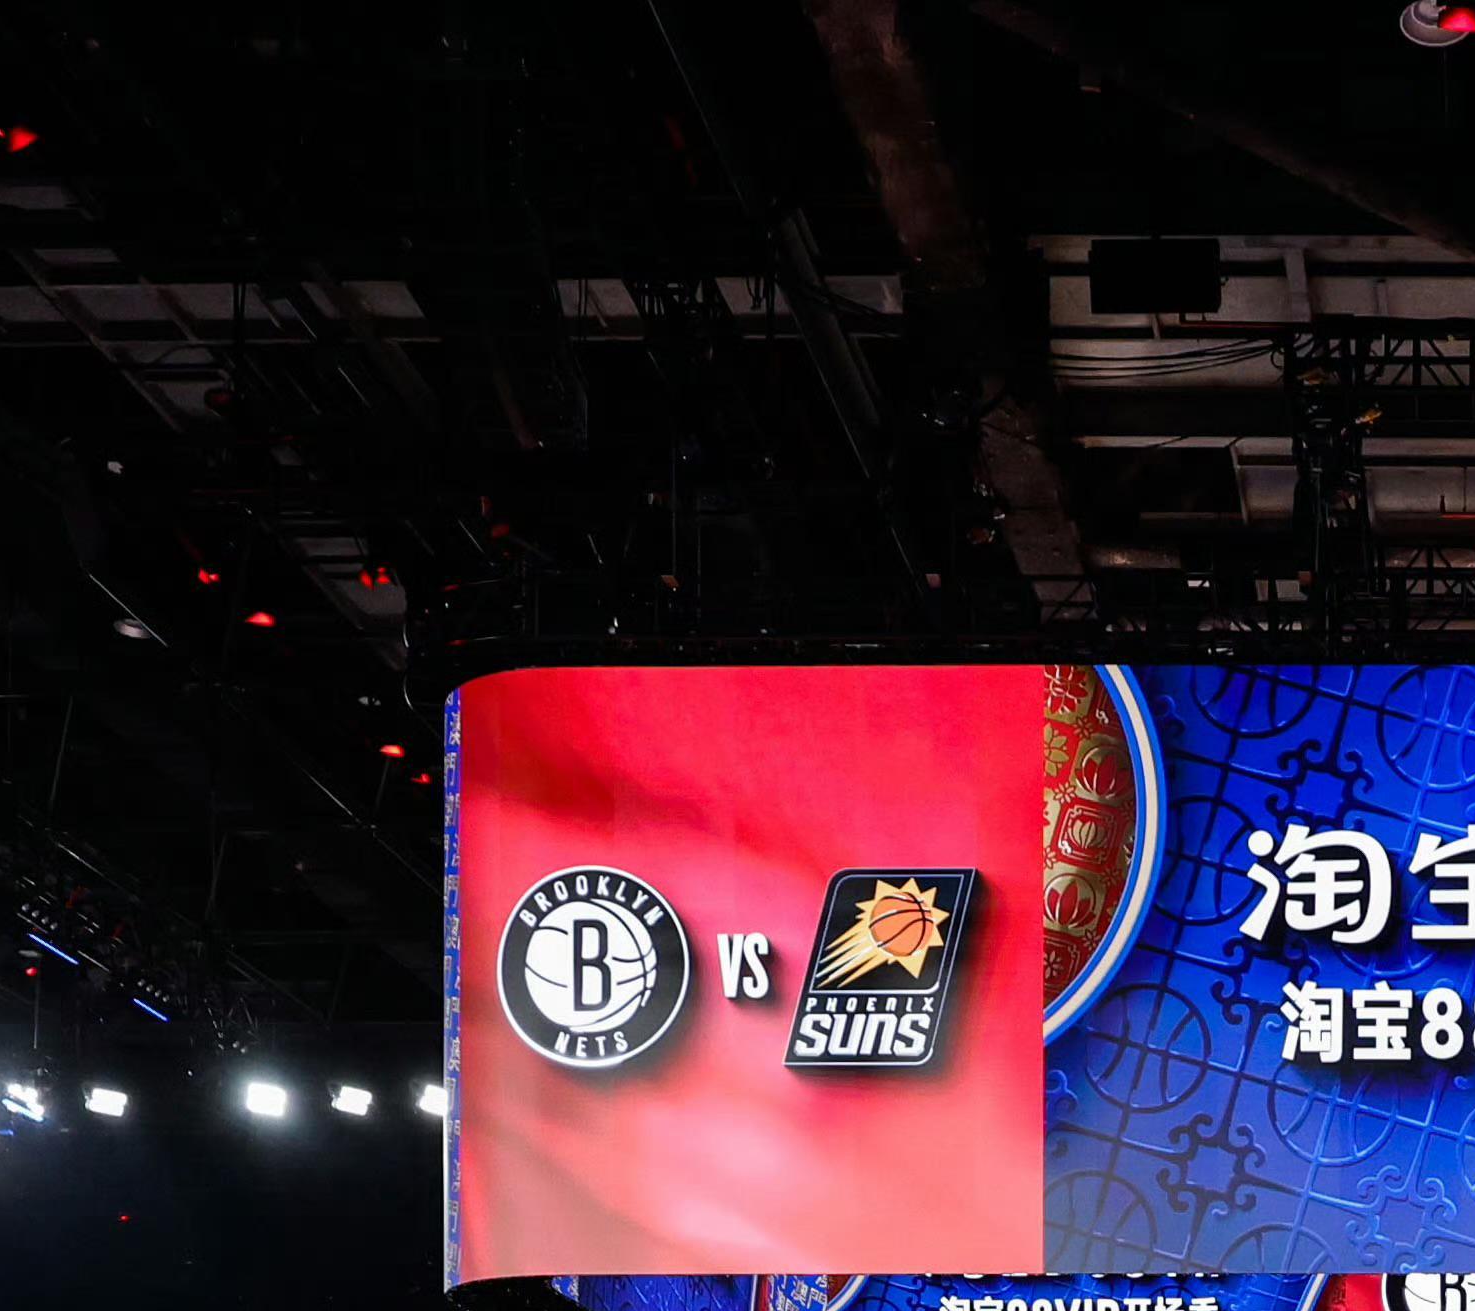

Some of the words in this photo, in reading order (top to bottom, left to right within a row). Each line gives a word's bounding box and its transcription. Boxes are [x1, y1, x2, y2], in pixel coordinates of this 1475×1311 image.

[519, 875, 665, 928] BROOKLYN
[718, 933, 769, 998] VS
[806, 997, 934, 1012] PHOENIX
[553, 1029, 630, 1058] NETS
[794, 1013, 930, 1057] SUNS
